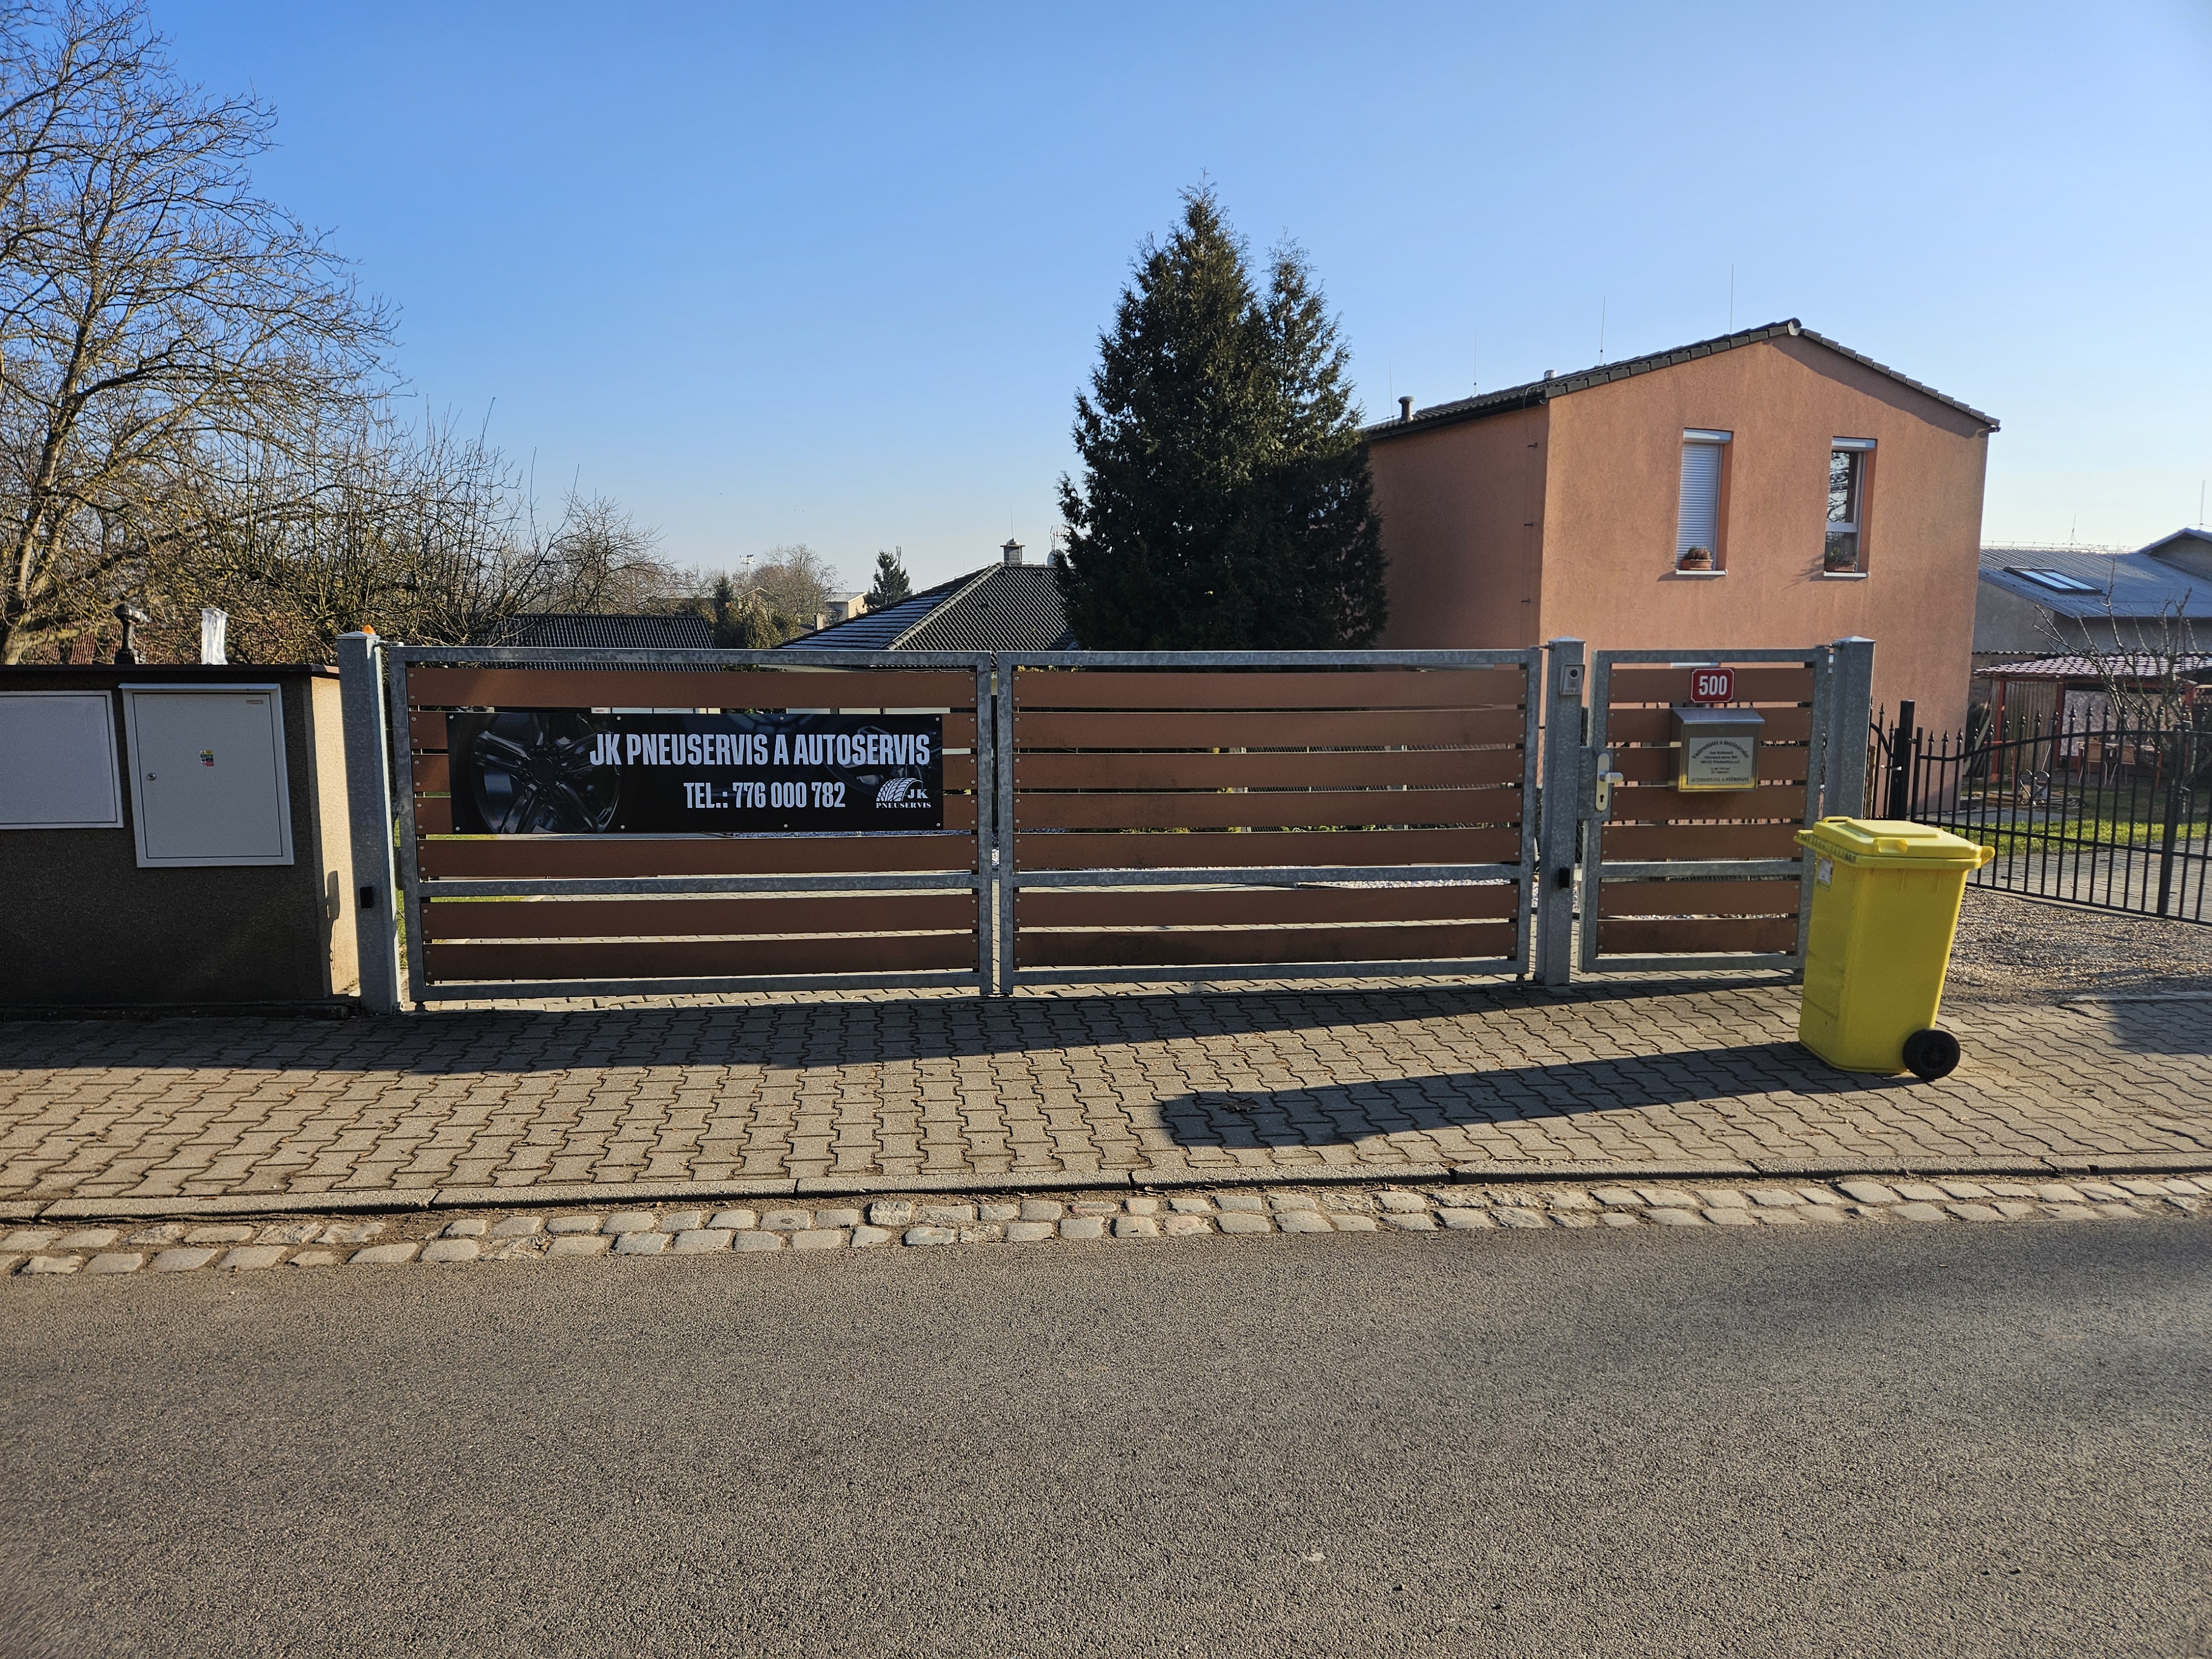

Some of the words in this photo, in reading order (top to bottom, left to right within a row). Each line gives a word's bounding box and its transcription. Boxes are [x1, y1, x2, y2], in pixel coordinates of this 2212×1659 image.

[1699, 675, 1728, 695] 500
[589, 734, 622, 765] JK
[626, 734, 768, 765] PNEUSERVIS
[774, 734, 789, 765] A
[794, 734, 930, 765] AUTOSERVIS
[684, 782, 728, 808] TEL.:
[733, 782, 766, 808] 776
[771, 782, 806, 807] 000
[811, 782, 846, 807] 782
[907, 789, 929, 799] JK
